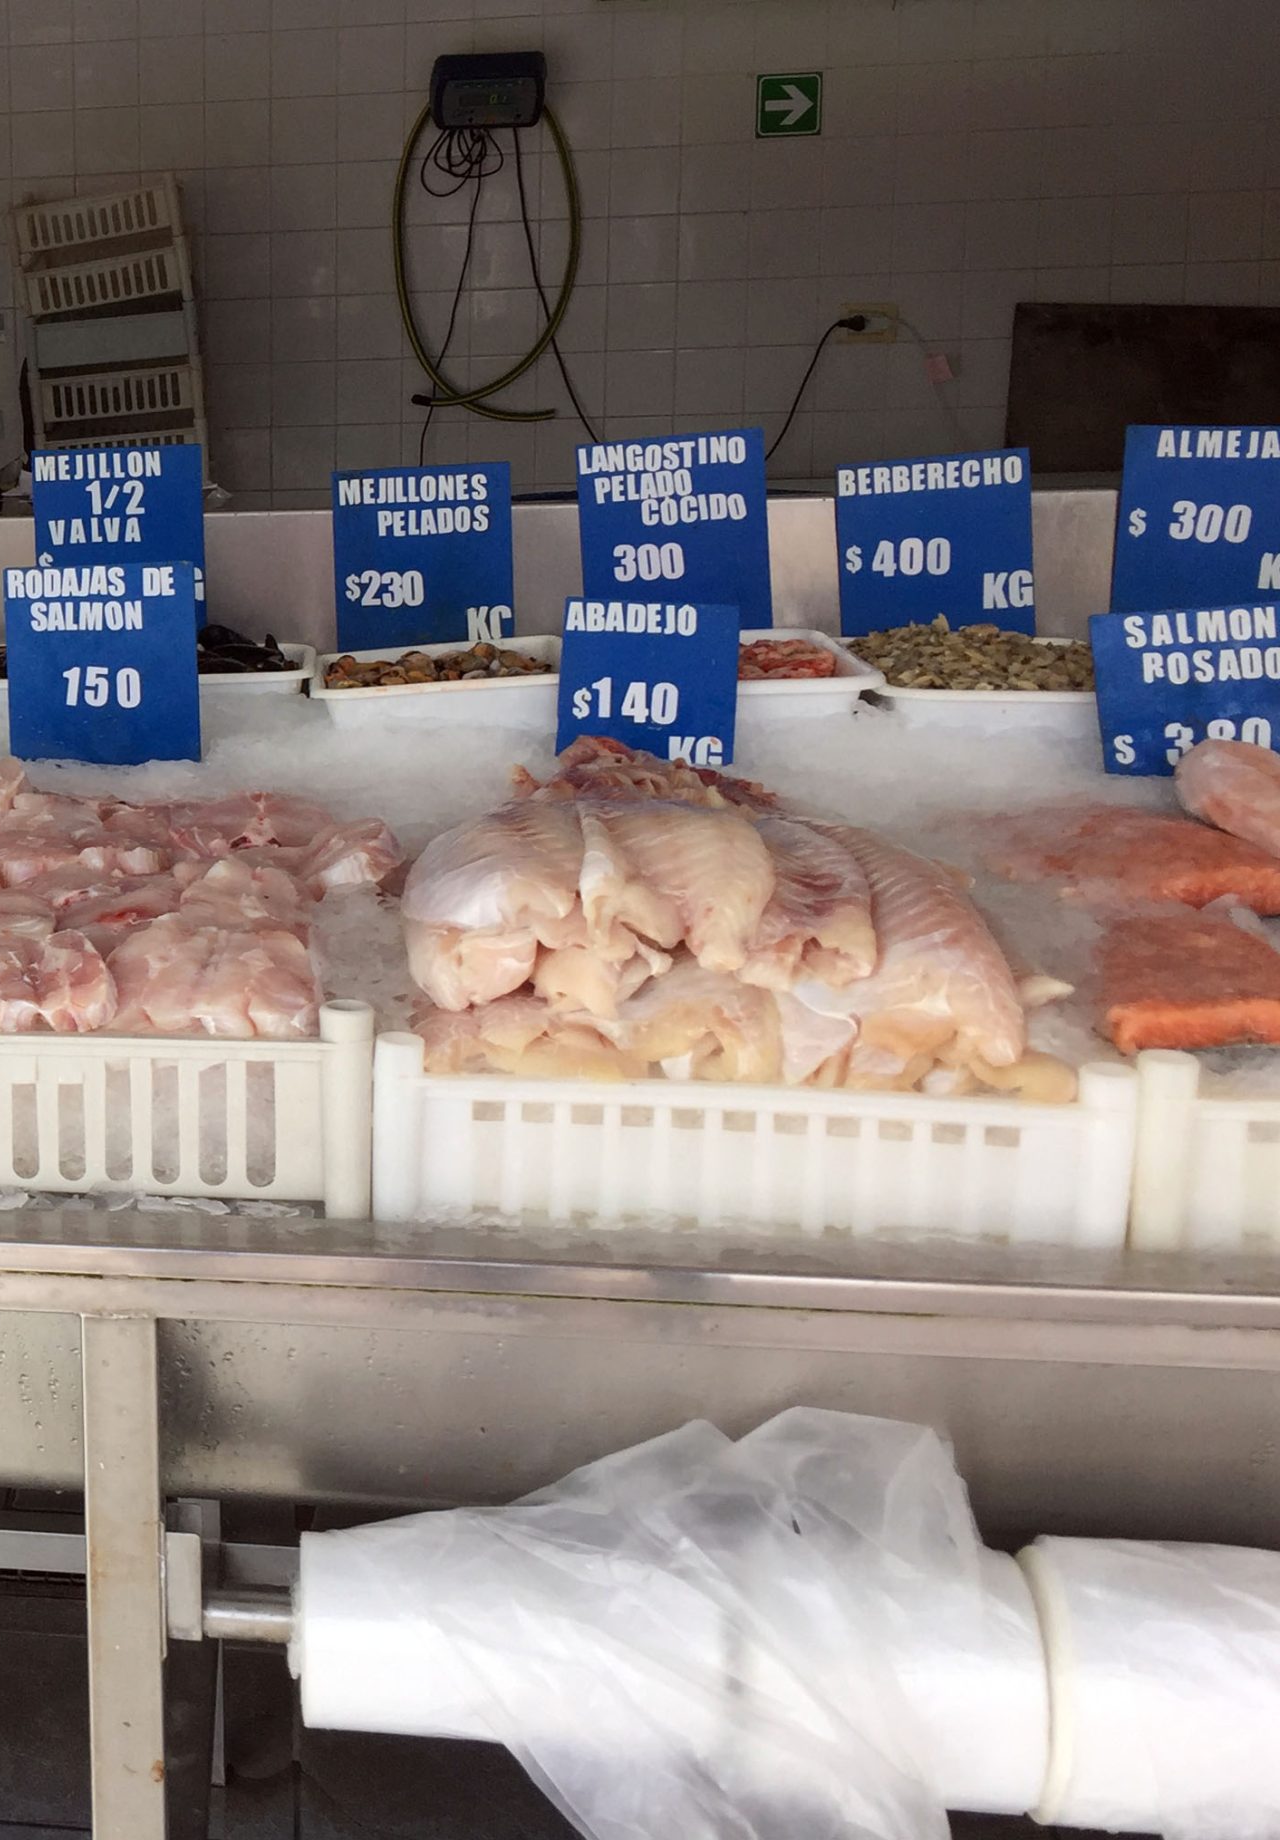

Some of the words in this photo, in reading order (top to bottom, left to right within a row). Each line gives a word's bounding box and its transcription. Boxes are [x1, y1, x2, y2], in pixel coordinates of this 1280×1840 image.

[577, 436, 747, 475] LANGOSTINO
[1156, 429, 1280, 459] ALMEJA
[34, 450, 162, 482] MEJILLON
[837, 455, 1023, 497] BERBERECHO
[85, 479, 145, 515] 1/2
[338, 473, 488, 506] MEJILLONES
[595, 468, 693, 504] PELADO
[377, 504, 490, 537] PELADOS
[641, 493, 747, 526] COCIDO
[1128, 507, 1147, 538] $
[1169, 500, 1252, 544] 300
[48, 516, 141, 546] VALVA
[613, 542, 685, 582] 300
[845, 545, 863, 574] $
[872, 537, 951, 577] 400
[7, 566, 126, 599] RODAJAS
[142, 566, 176, 597] DE
[982, 570, 1034, 610] KG
[30, 600, 143, 632] SALMON
[565, 601, 698, 637] ABADEJO
[1123, 606, 1276, 649] SALMON
[1142, 646, 1280, 685] ROSADO
[62, 666, 141, 709] 150
